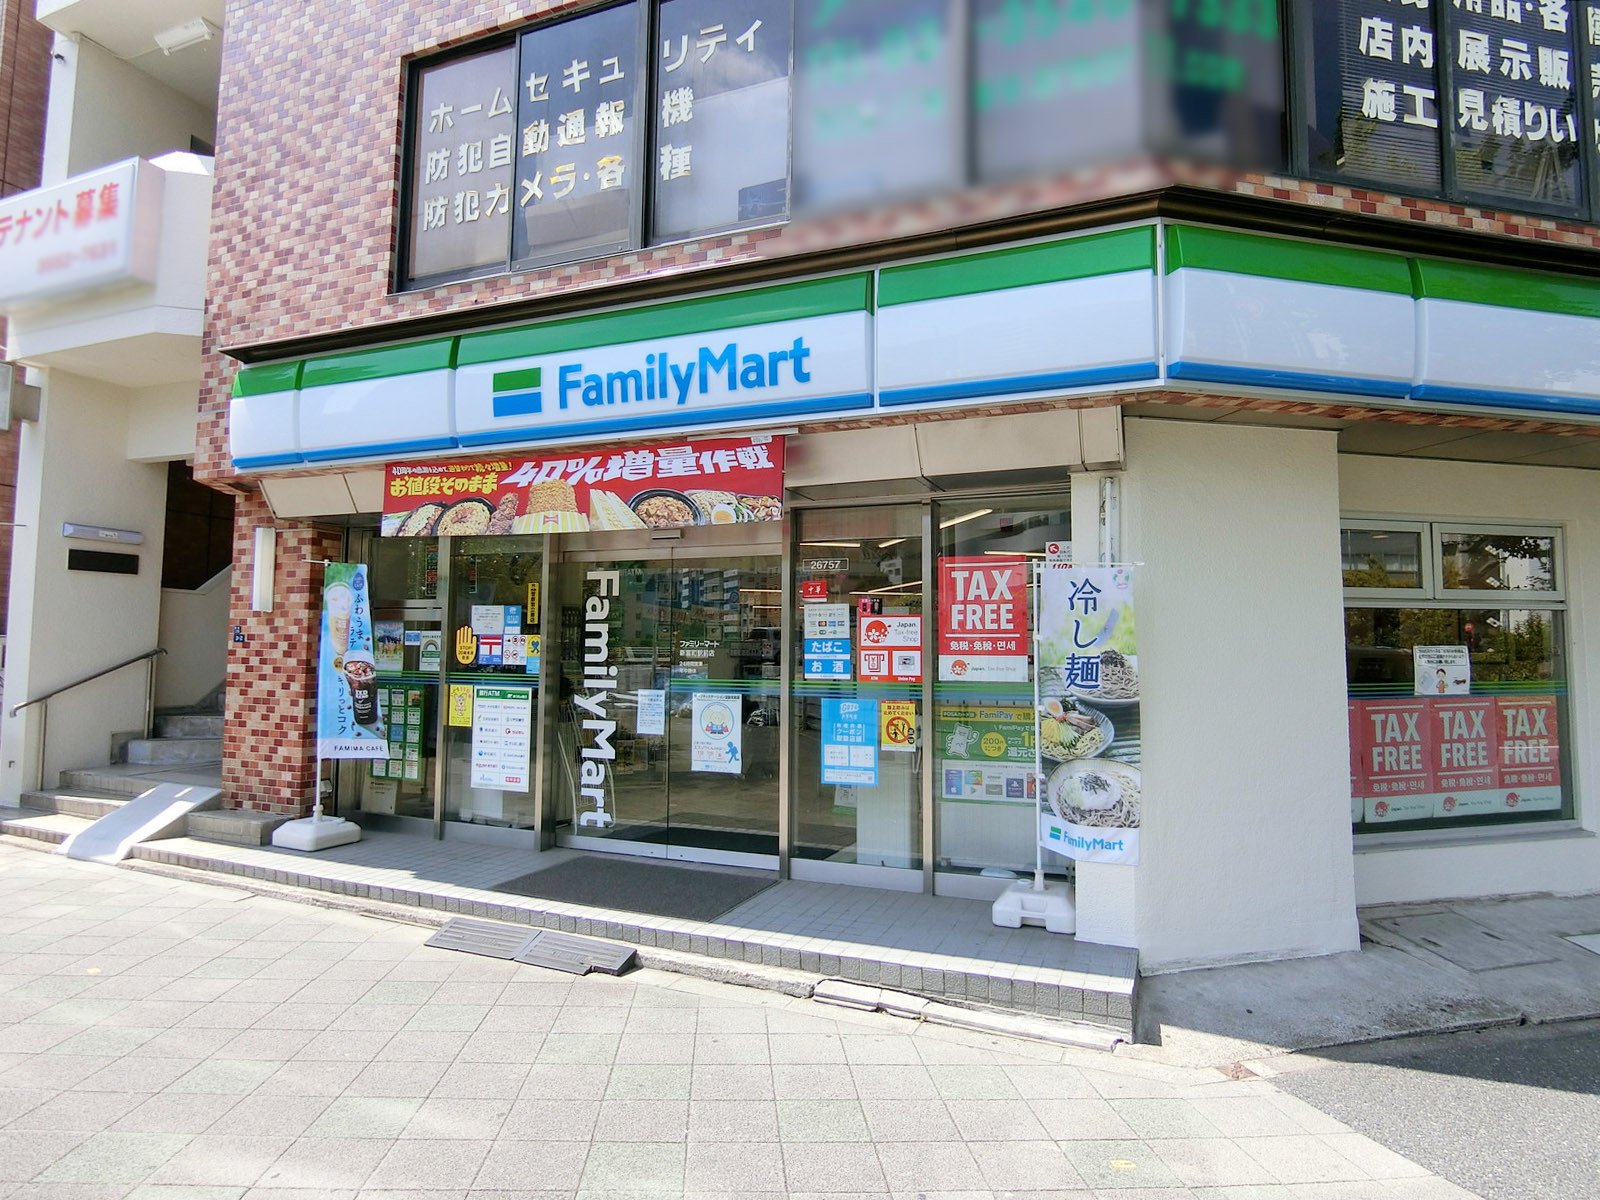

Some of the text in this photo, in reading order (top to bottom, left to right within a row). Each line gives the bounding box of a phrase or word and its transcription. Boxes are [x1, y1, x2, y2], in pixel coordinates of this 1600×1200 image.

[559, 337, 810, 410] FamilyMart
[499, 445, 775, 488] 40%増量作戦
[390, 472, 498, 497] お値段そのまま
[810, 561, 841, 570] 26757
[951, 570, 1012, 600] TAX
[951, 604, 1014, 630] FREE
[680, 640, 720, 648] ファミリーマート
[811, 641, 844, 652] たばこ
[1064, 577, 1102, 690] 冷し麺
[574, 570, 620, 828] FamilyMart
[1371, 712, 1420, 743] TAX
[1439, 709, 1486, 740] TAX
[1503, 708, 1548, 736] TAX
[1372, 744, 1423, 772] FREE
[1440, 741, 1489, 768] FREE
[1504, 738, 1551, 764] FREE
